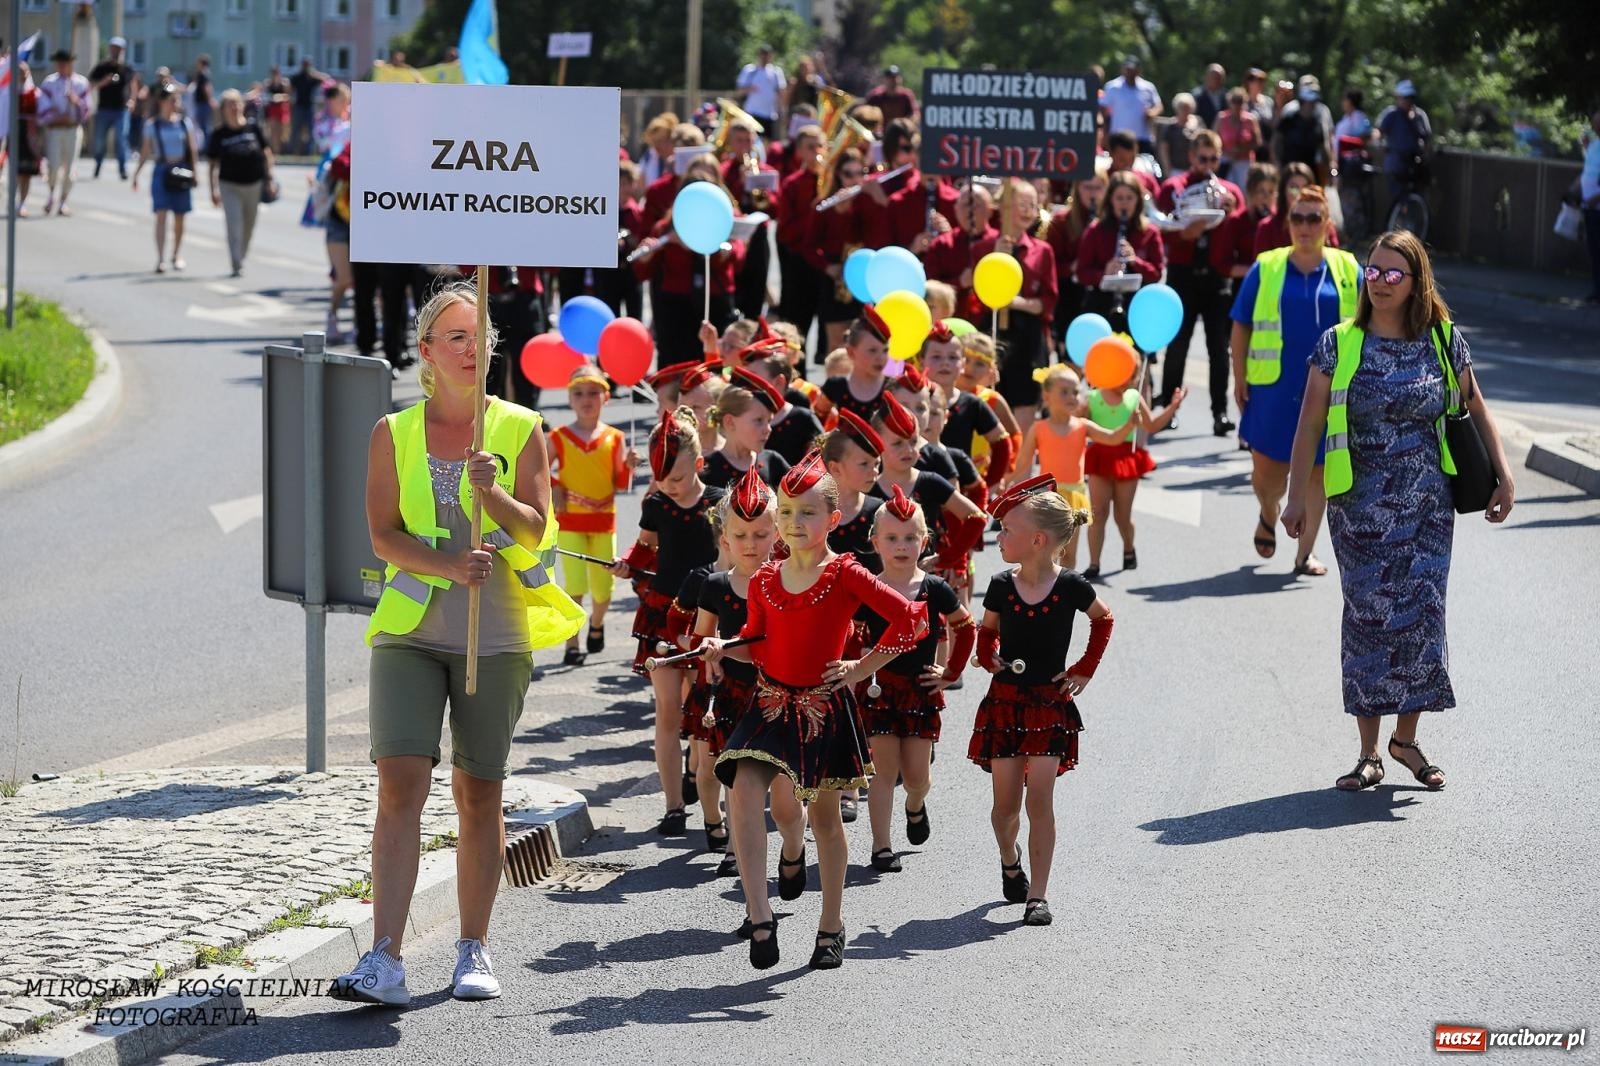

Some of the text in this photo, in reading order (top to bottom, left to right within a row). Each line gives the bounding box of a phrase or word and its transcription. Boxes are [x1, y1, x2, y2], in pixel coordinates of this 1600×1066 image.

[931, 72, 1087, 100] MŁODZIEŻOWA
[925, 105, 1094, 135] ORKIESTRA DĘTA
[431, 139, 540, 172] ZARA
[938, 133, 1078, 173] Silenzio
[363, 190, 606, 215] POWIAT RACIBORSKI
